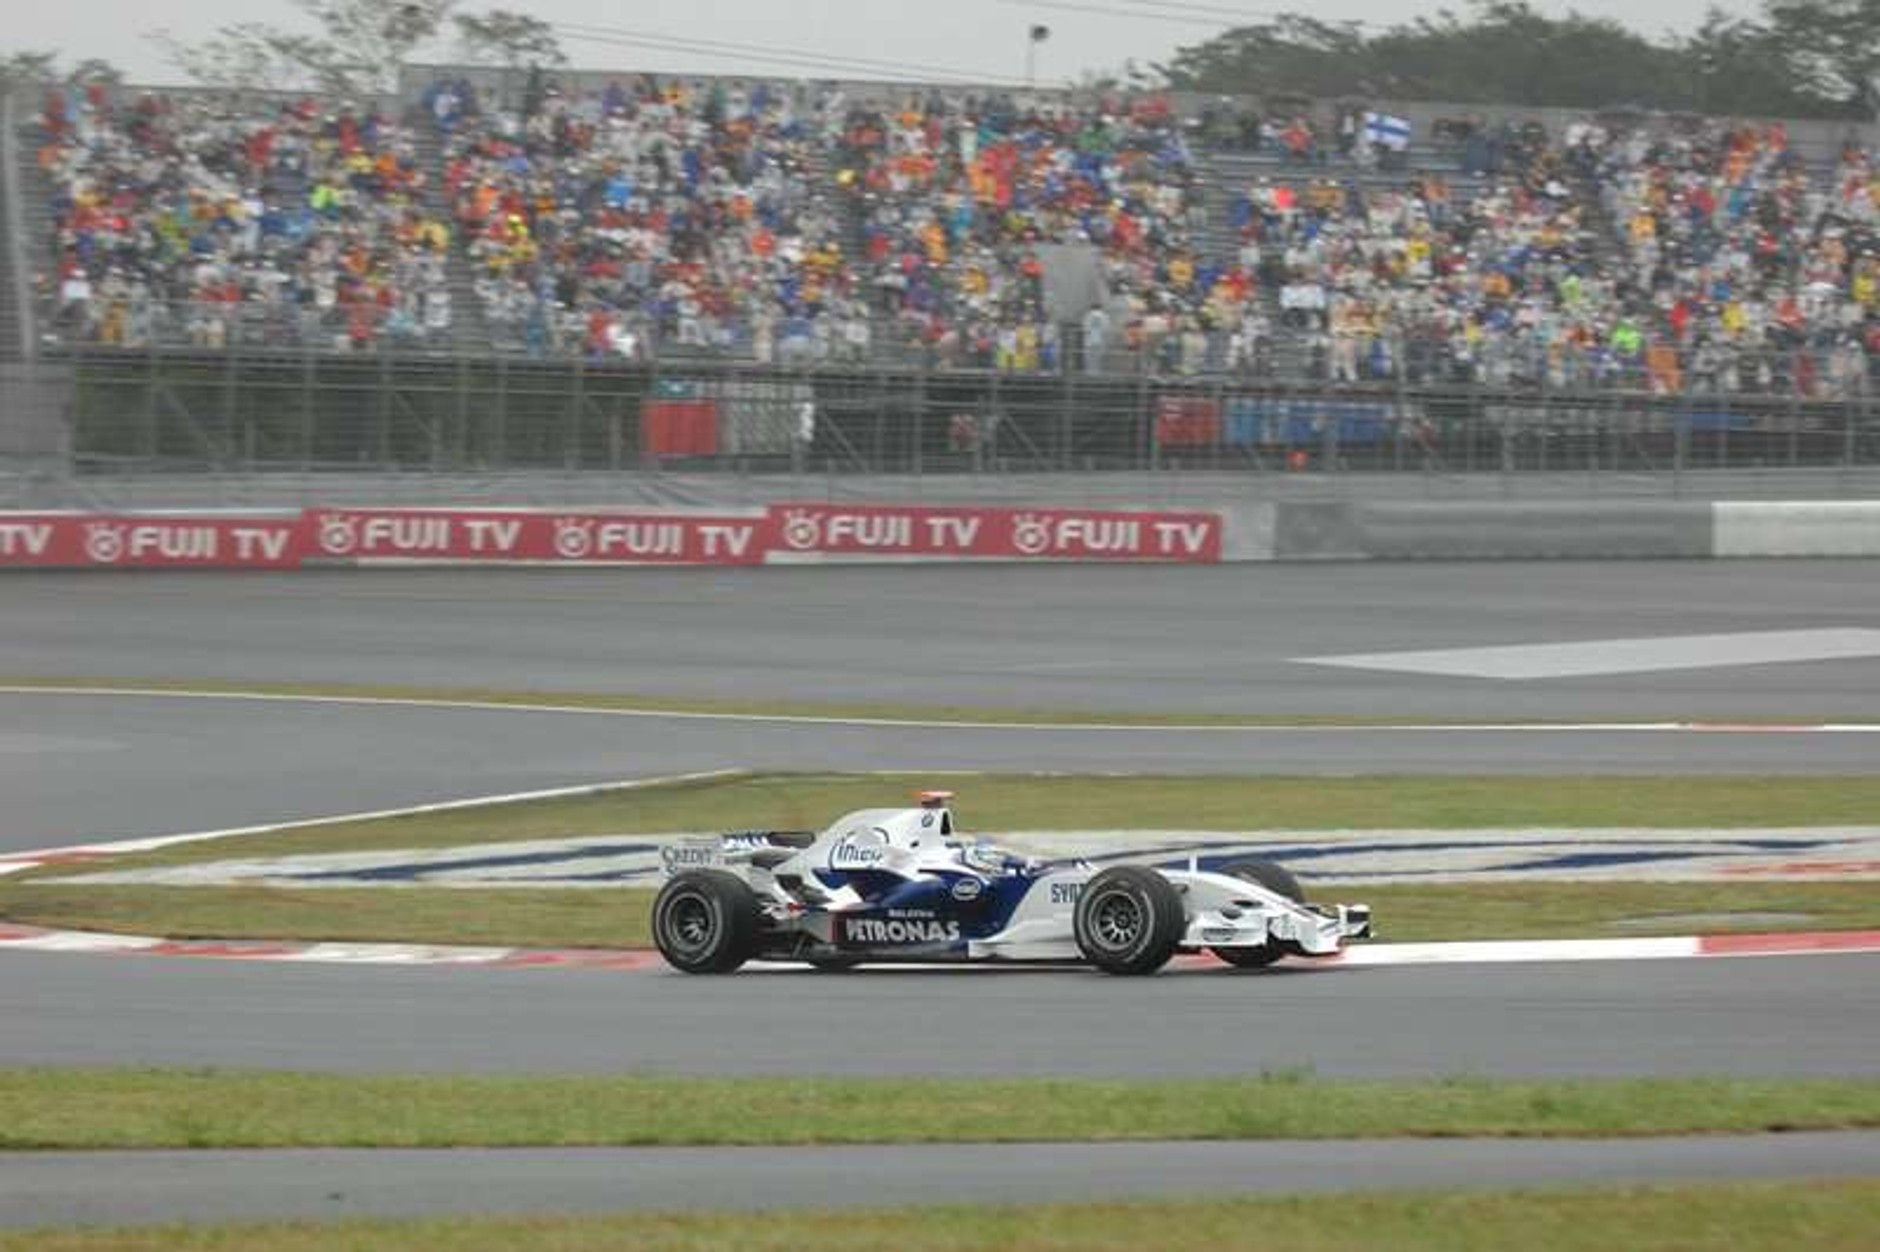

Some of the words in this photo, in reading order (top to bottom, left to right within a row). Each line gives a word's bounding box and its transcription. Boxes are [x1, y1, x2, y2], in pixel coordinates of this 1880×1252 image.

[0, 523, 53, 555] TV
[129, 525, 218, 558] FUJI
[230, 528, 291, 560] TV
[363, 518, 448, 550] FUJI
[463, 520, 521, 551] TV
[600, 524, 683, 554] FUJI
[697, 525, 754, 556] TV
[827, 514, 912, 547] FUJI
[926, 516, 980, 548] TV
[1056, 518, 1139, 551] FUJI
[1155, 522, 1210, 553] TV
[846, 919, 961, 942] PETRONAS
